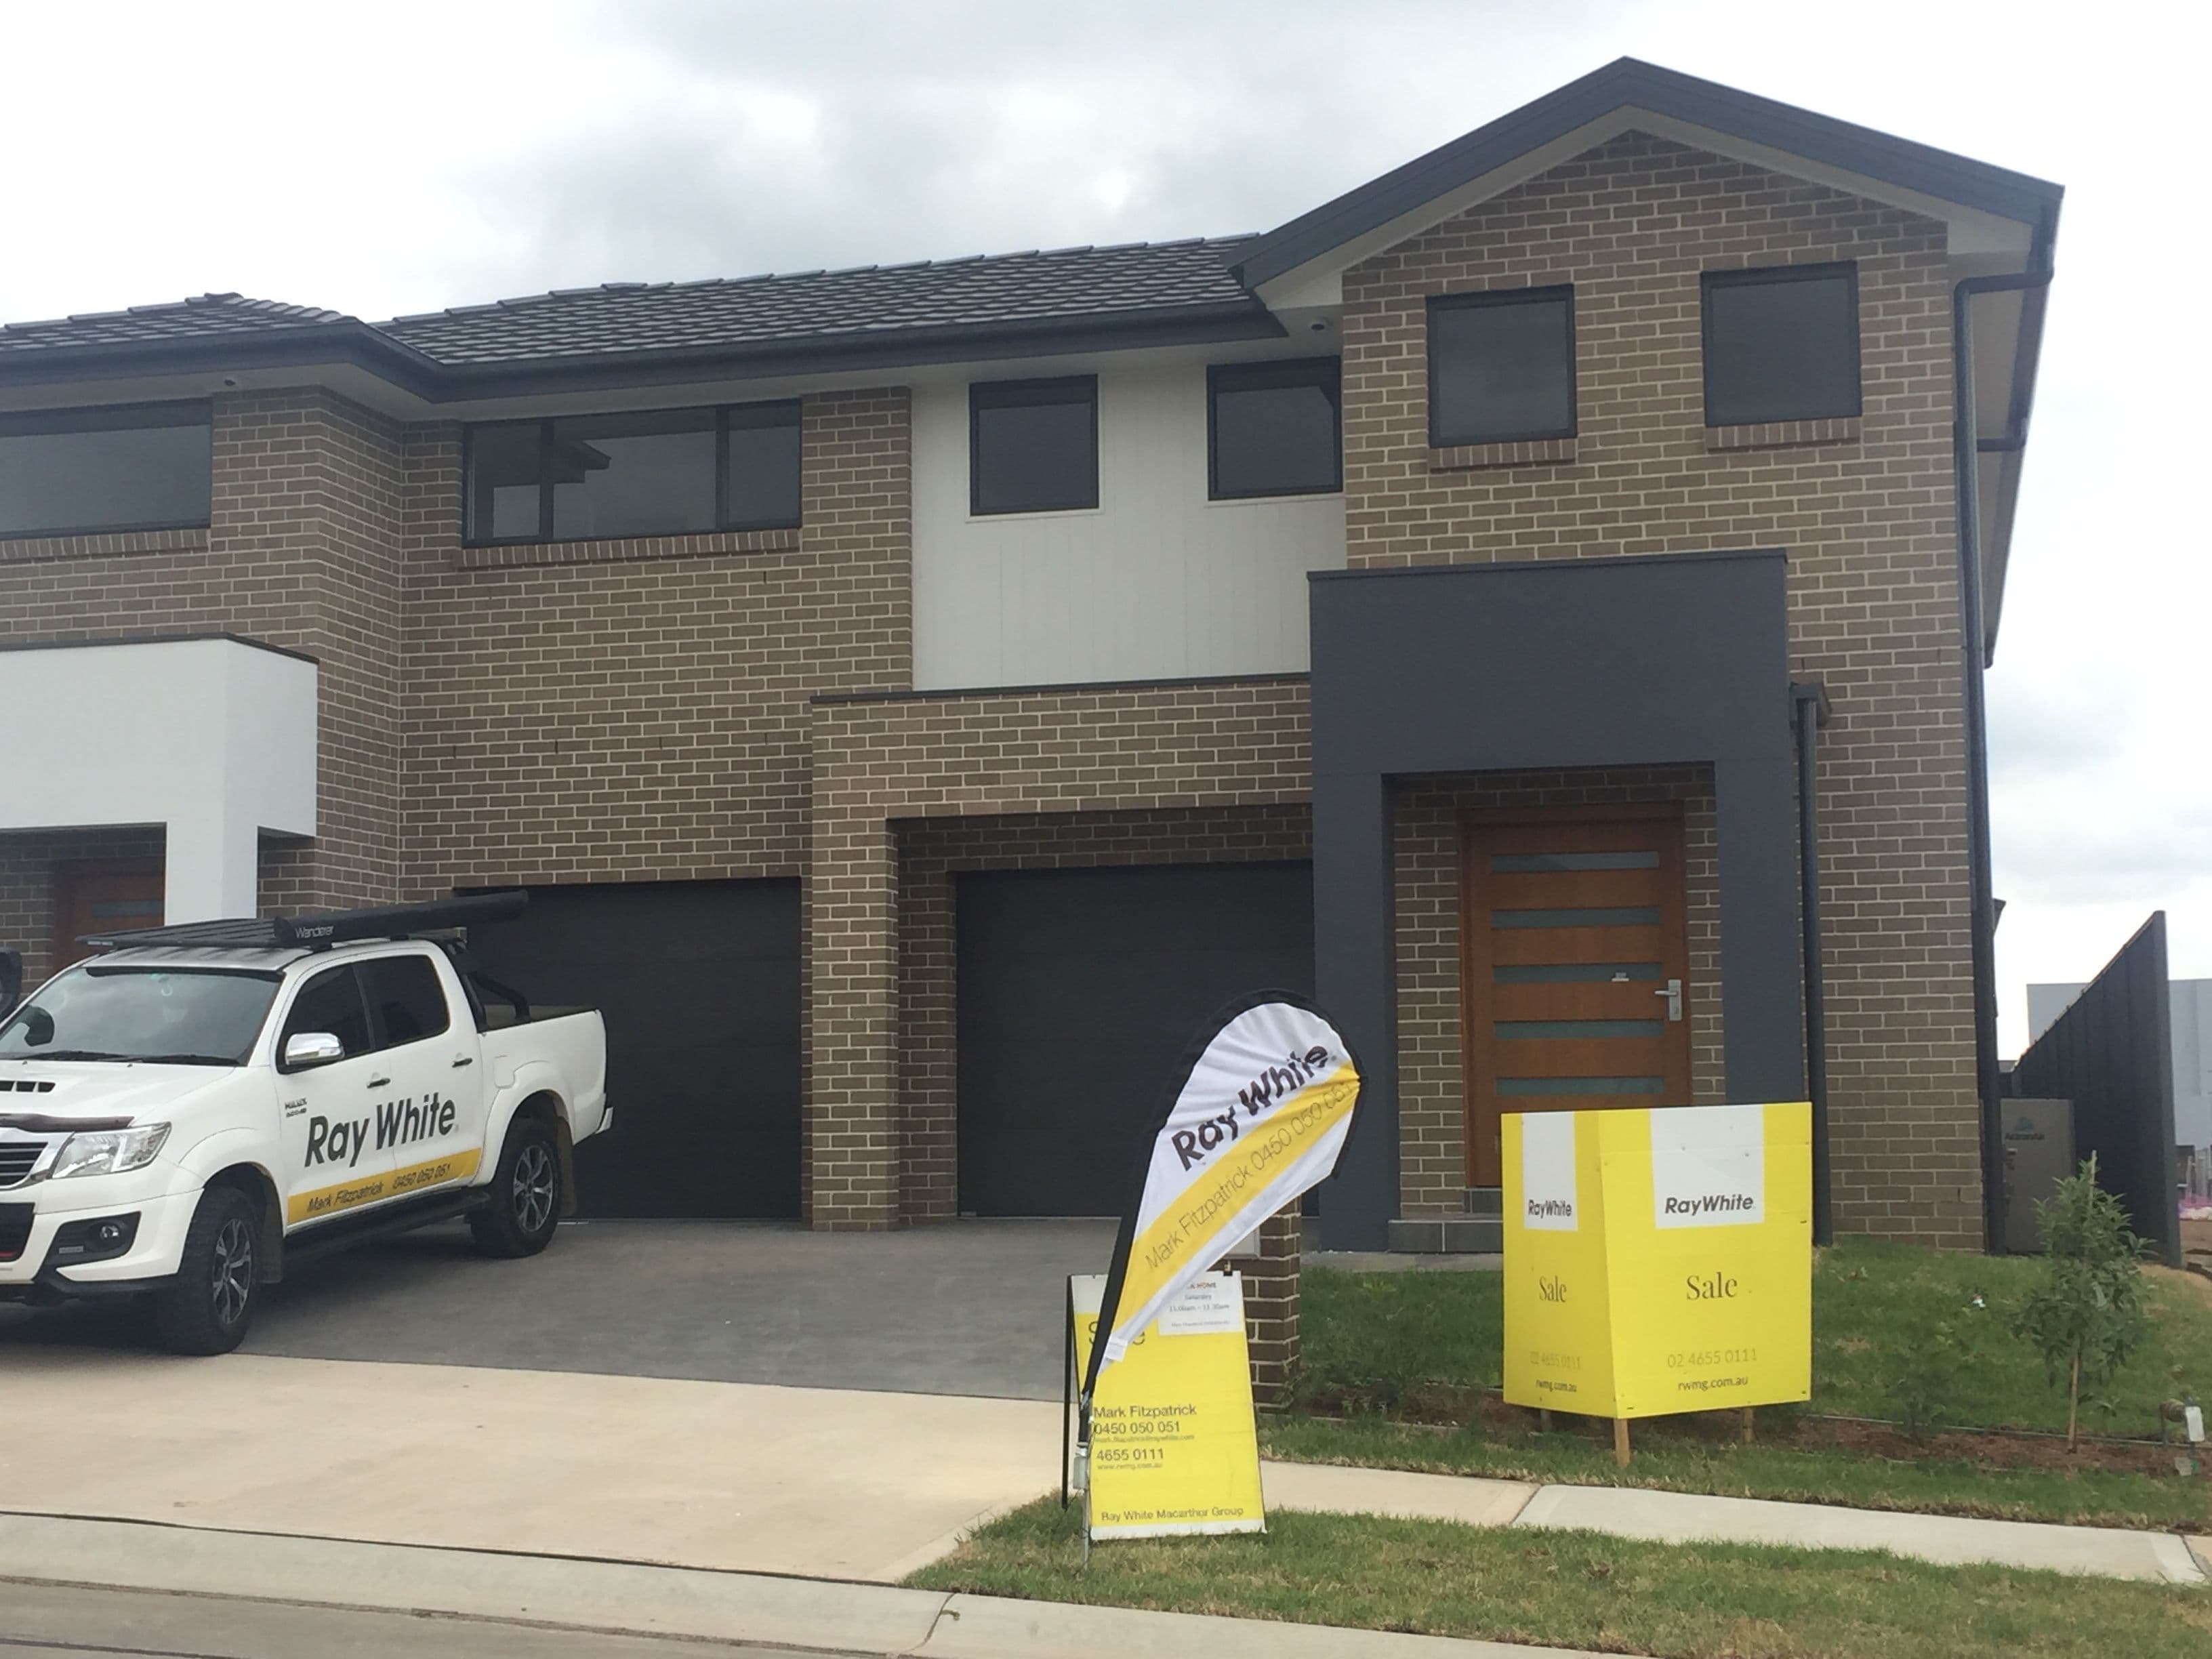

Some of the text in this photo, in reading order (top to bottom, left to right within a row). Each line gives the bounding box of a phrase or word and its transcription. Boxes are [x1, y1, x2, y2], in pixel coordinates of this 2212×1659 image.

[1171, 1045, 1329, 1172] Ray White
[304, 1092, 455, 1168] Ray White
[1145, 1232, 1185, 1270] Mark
[1178, 1164, 1254, 1238] Fitzpatrick
[1250, 1127, 1293, 1172] 0450
[1290, 1102, 1323, 1137] 050
[307, 1194, 332, 1212] Mark
[1539, 1275, 1567, 1303] Sale
[1686, 1271, 1738, 1300] Sale
[1667, 1348, 1758, 1368] 02 4655 0111
[1677, 1376, 1748, 1392] rwmg.com.au
[1094, 1404, 1197, 1418] Mark Fitzpatrick
[1094, 1420, 1181, 1435] 0450 050 051
[1097, 1448, 1164, 1462] 4655 0111
[1101, 1506, 1244, 1523] Ray White Macarthur Group
